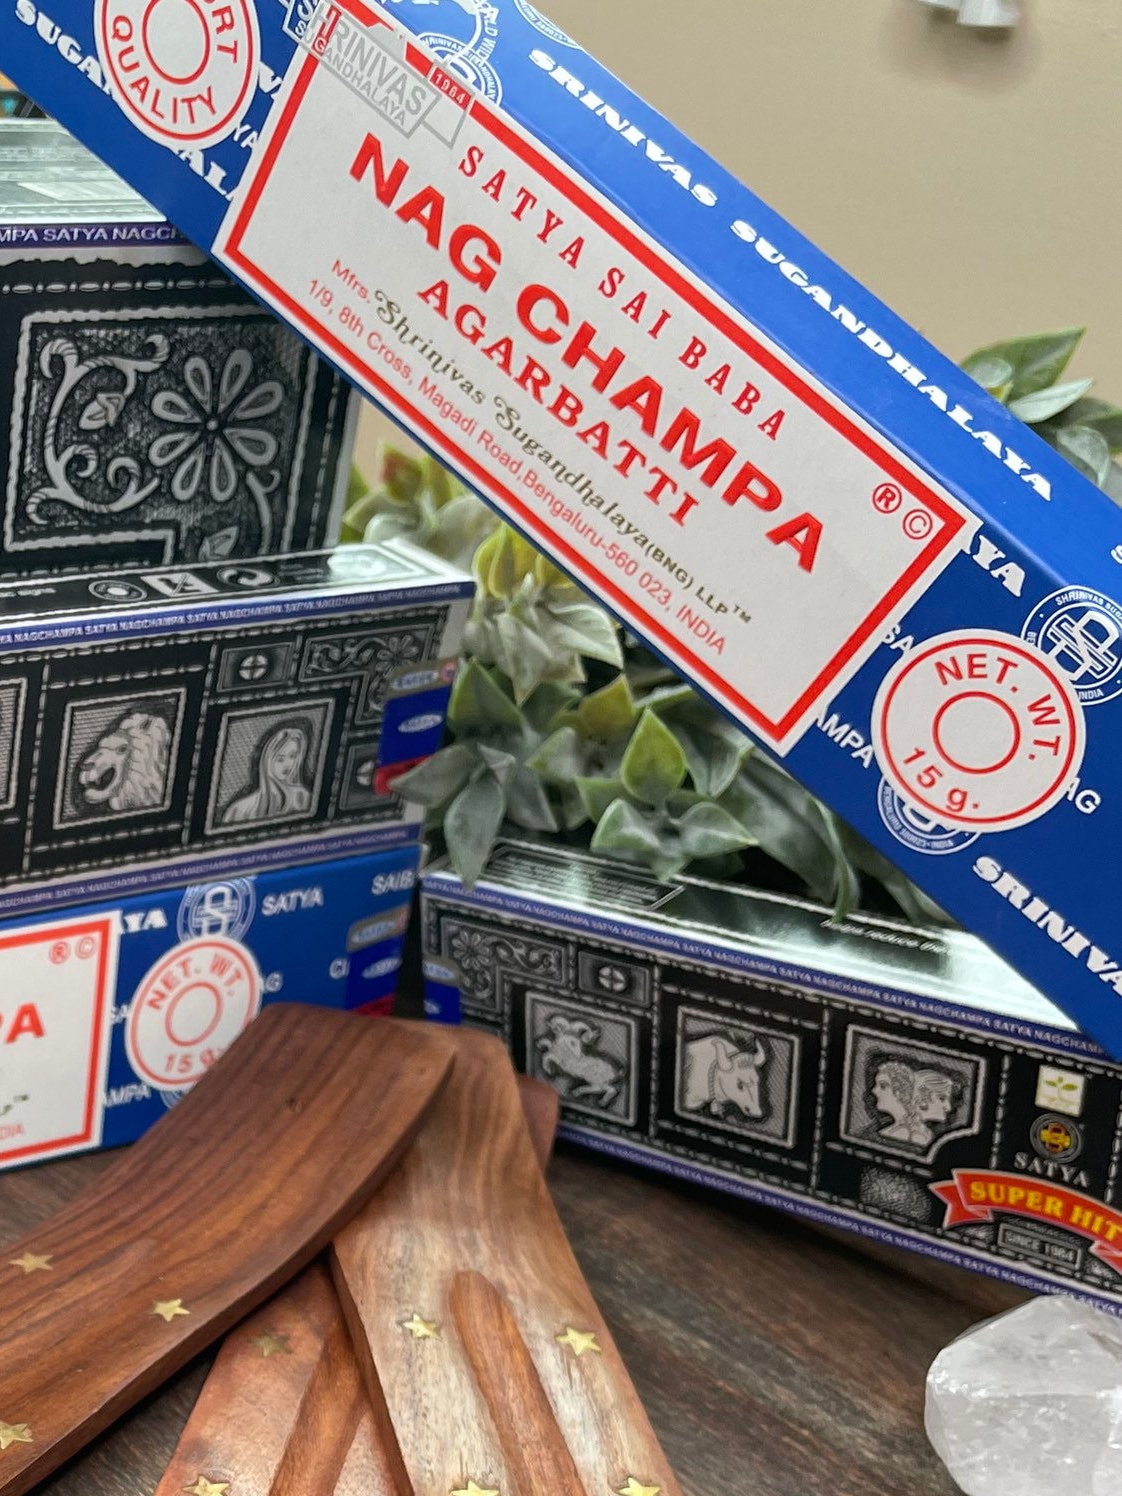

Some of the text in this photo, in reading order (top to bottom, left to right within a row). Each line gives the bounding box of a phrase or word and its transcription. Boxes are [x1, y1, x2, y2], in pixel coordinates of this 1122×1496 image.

[112, 15, 216, 124] QUALITY
[43, 227, 108, 242] SATYA
[529, 48, 1052, 501] SRINIVAS SUGANDHALAYA
[331, 259, 372, 304] Mfrs.
[374, 289, 487, 405] Shrinivas
[458, 145, 786, 442] SATYA SAI BABA
[349, 132, 825, 574] NAG CHAMPA
[417, 279, 699, 527] AGARBATTI
[309, 279, 334, 315] 1/9,
[338, 306, 364, 338] 8th
[366, 331, 414, 386] Cross,
[418, 376, 478, 437] Magadi
[638, 571, 672, 612] 023,
[676, 604, 727, 656] INDIA
[934, 653, 1061, 760] NET. WT.
[903, 747, 979, 812] 15 g.
[262, 886, 325, 917] SATYA
[146, 957, 202, 1011] NET.
[919, 1002, 1032, 1038] NAGCHAMPA SATYA
[164, 1053, 193, 1075] 15
[970, 1180, 1064, 1219] SUPER
[1069, 1203, 1122, 1242] HIT
[1013, 1151, 1088, 1189] SATYA
